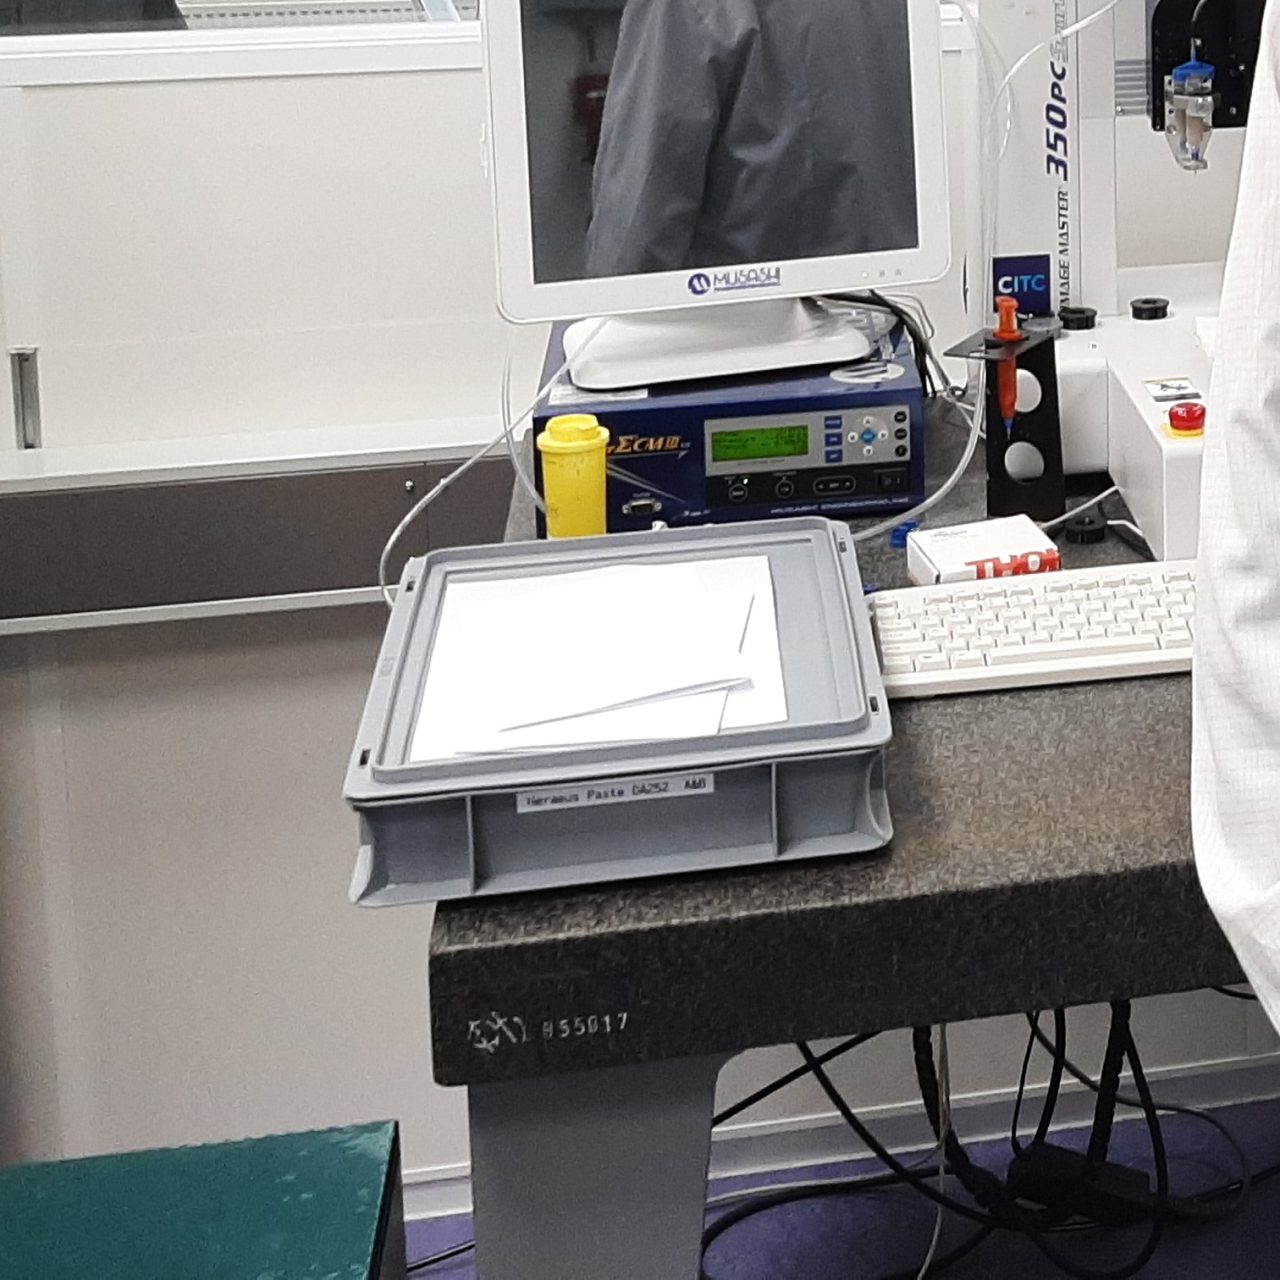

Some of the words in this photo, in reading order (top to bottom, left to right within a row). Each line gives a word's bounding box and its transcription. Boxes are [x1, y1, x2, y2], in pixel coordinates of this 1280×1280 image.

[1057, 191, 1069, 255] MASTER
[713, 267, 780, 287] MUSASHI
[998, 274, 1047, 294] CITC
